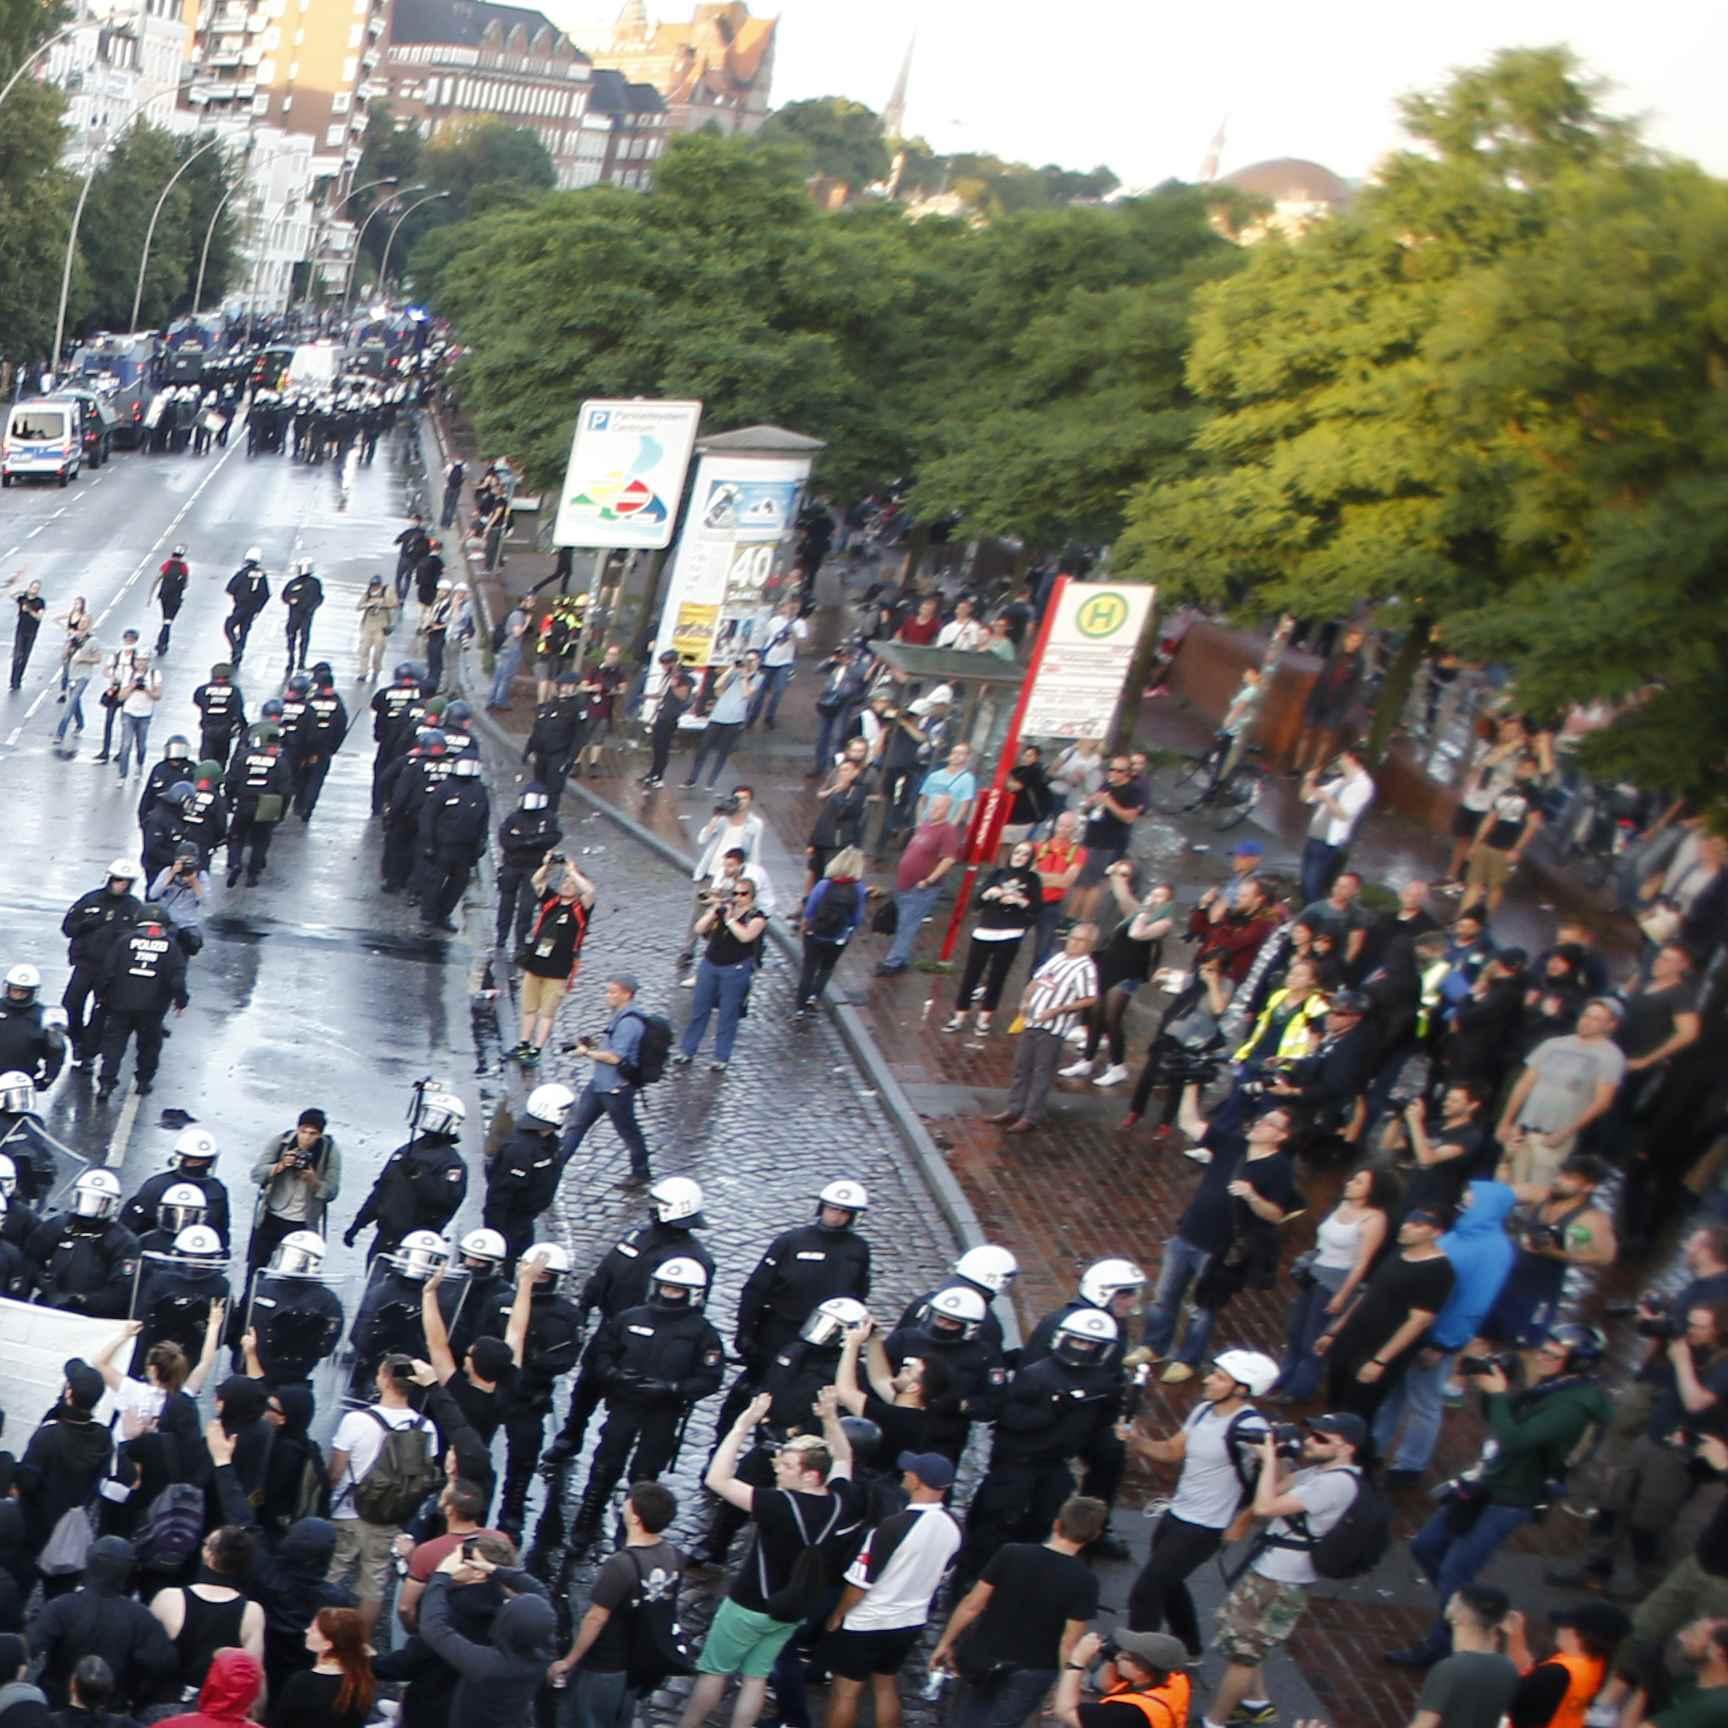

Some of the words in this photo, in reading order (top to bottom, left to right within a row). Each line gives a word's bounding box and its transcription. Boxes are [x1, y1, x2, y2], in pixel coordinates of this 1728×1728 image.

[592, 412, 607, 430] P
[730, 546, 773, 588] 40
[1089, 604, 1115, 627] H
